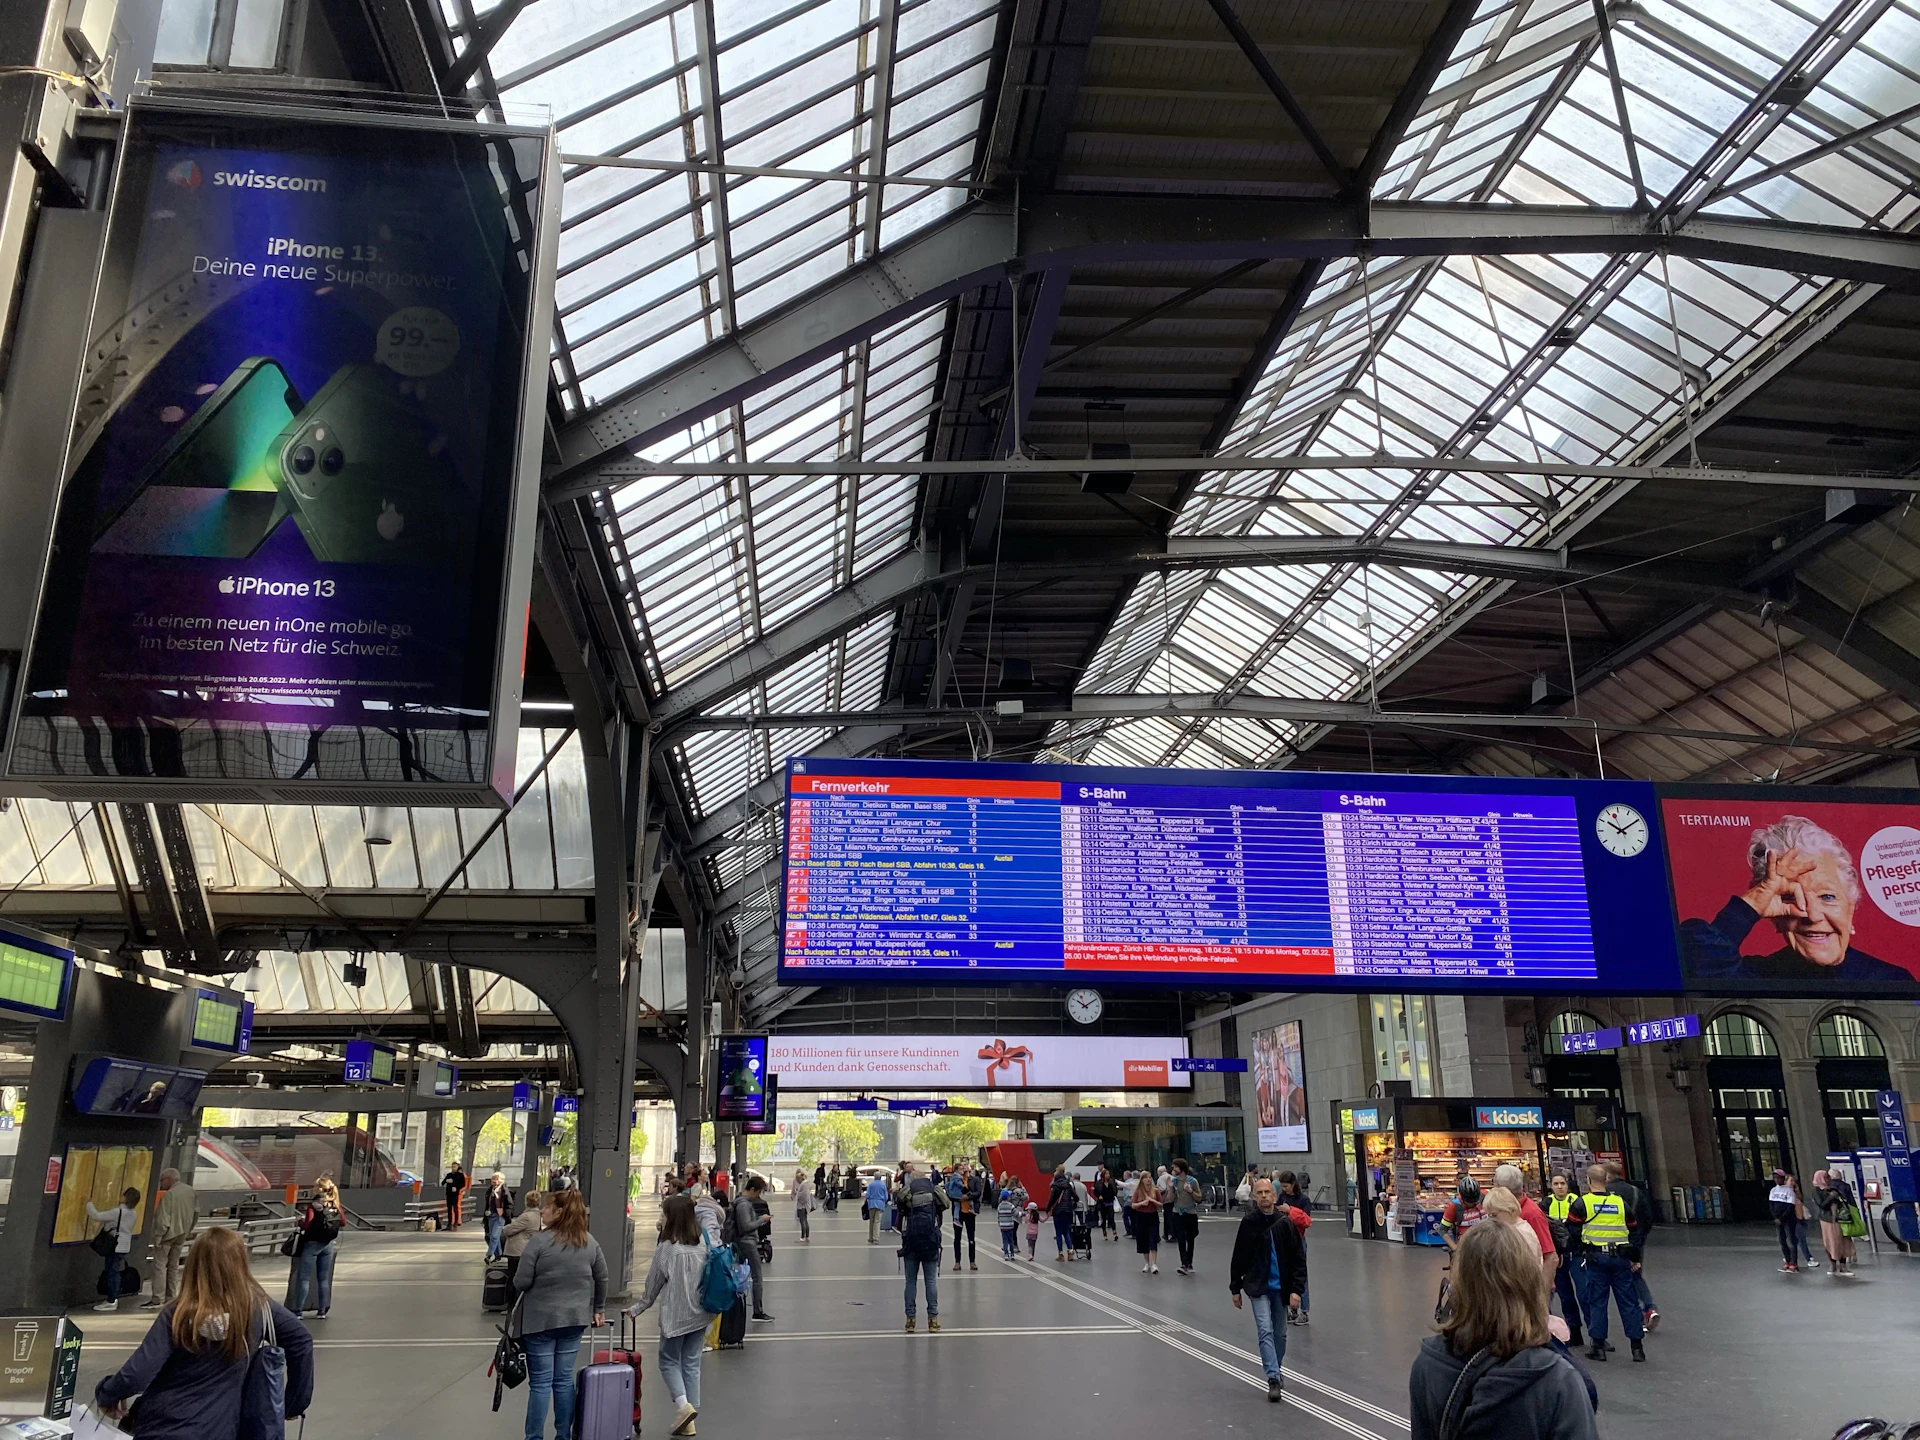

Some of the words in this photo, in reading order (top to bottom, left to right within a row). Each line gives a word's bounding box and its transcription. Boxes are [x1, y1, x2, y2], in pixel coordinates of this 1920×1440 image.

[213, 169, 327, 193] swisscom
[267, 237, 344, 259] iPhone
[351, 245, 384, 262] 13.
[192, 255, 256, 276] Deine
[263, 264, 317, 281] neue
[236, 577, 309, 597] iPhone
[313, 579, 336, 597] 13
[158, 614, 212, 630] einem
[216, 617, 270, 632] neuen
[274, 616, 326, 633] inOne
[330, 618, 387, 635] mobile
[166, 634, 224, 652] besten
[229, 636, 268, 653] Netz
[272, 637, 297, 654] für
[301, 639, 327, 654] die
[238, 675, 248, 683] bis
[289, 677, 307, 685] Mehr
[308, 677, 337, 685] erfahren
[338, 678, 356, 686] unter
[271, 687, 341, 696] swisscom.ch/bestnet
[811, 780, 890, 793] Fernverkehr
[1079, 787, 1127, 799] S-Bahn
[1339, 794, 1386, 807] S-Bahn
[890, 819, 922, 827] Landquart
[1679, 814, 1750, 827] TERTIANUM
[1878, 849, 1914, 860] bewerben
[1899, 908, 1917, 917] einer
[1097, 953, 1117, 961] Prüfen
[1143, 954, 1178, 962] Verbindung
[770, 1048, 789, 1057] 180
[791, 1047, 842, 1057] Millionen
[845, 1047, 861, 1057] für
[864, 1049, 899, 1057] unsere
[902, 1047, 959, 1057] Kundinnen
[348, 1068, 361, 1078] 12
[770, 1062, 791, 1072] und
[793, 1062, 835, 1072] Kunden
[838, 1062, 865, 1072] dank
[867, 1062, 951, 1072] Genossenschaft.
[1358, 1112, 1377, 1127] kiosk
[1479, 1111, 1490, 1125] k
[1492, 1110, 1540, 1125] kiosk
[1892, 1157, 1909, 1165] WC
[18, 1333, 30, 1356] kooky.
[62, 1336, 81, 1350] kooky.
[4, 1367, 34, 1376] DropOff
[9, 1376, 25, 1384] Box
